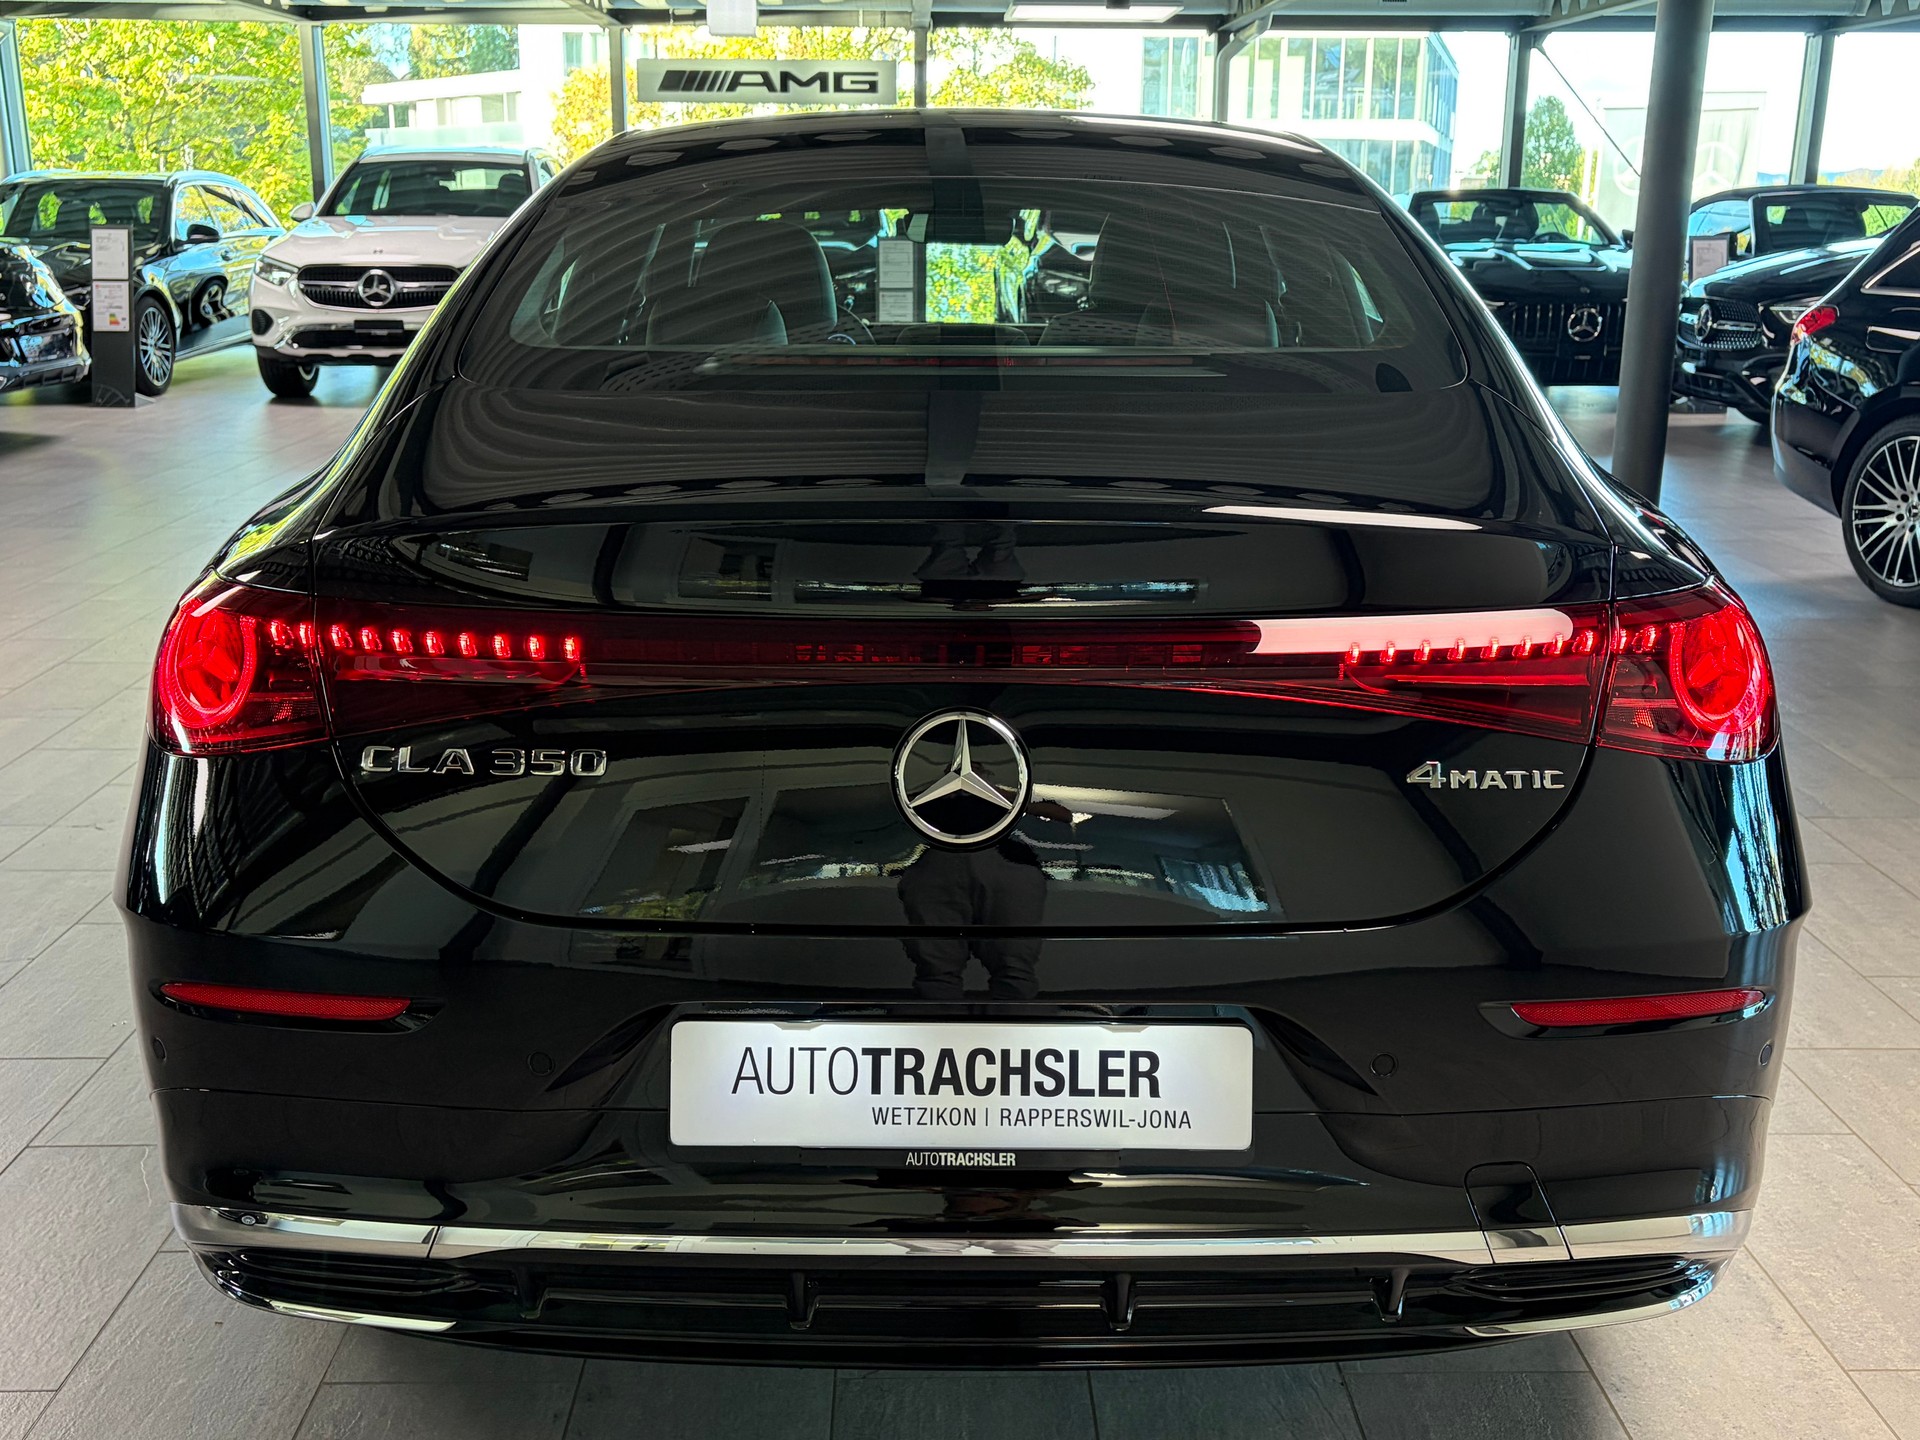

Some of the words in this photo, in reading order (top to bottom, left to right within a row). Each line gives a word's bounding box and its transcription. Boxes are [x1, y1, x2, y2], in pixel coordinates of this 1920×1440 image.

[726, 69, 879, 94] AMG
[361, 745, 475, 776] CLA
[489, 748, 607, 776] 350
[1406, 760, 1565, 790] 4MATIC
[731, 1046, 1161, 1098] AUTOTRACHSLER
[872, 1106, 976, 1126] WETZIKON
[1000, 1107, 1192, 1130] RAPPERSWIL-JONA
[905, 1151, 1016, 1167] AUTOTRACHSLER
